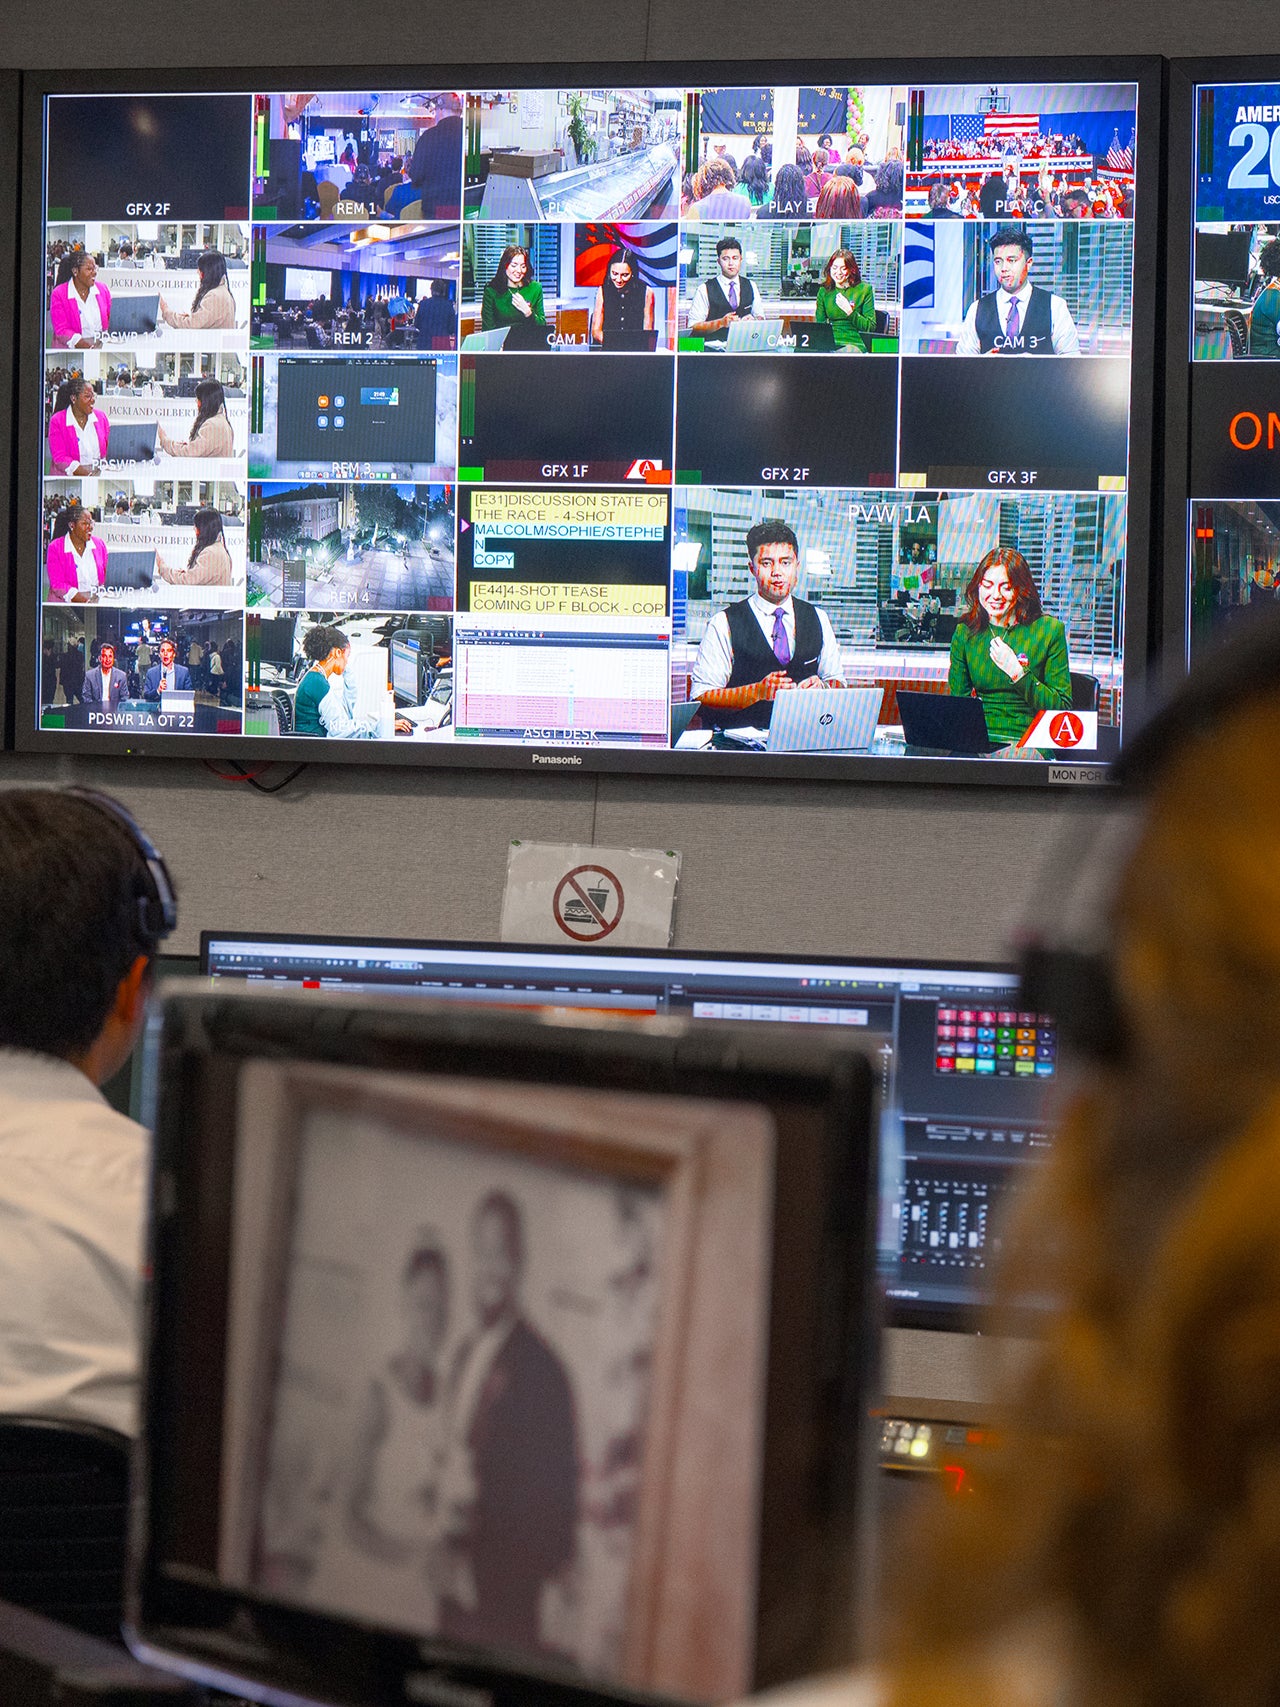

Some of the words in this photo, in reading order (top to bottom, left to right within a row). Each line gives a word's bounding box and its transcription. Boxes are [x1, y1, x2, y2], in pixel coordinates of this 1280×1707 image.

[1263, 195, 1280, 204] USC
[126, 203, 151, 216] GFX
[155, 203, 171, 215] 2F
[336, 202, 364, 214] REM
[369, 203, 377, 214] 1
[768, 201, 801, 213] PLAY
[806, 201, 816, 213] B
[995, 200, 1030, 213] PLAY
[1032, 201, 1044, 213] C
[135, 278, 155, 289] AND
[157, 278, 199, 289] GILBERT
[334, 332, 362, 344] REM
[366, 333, 373, 344] 2
[546, 333, 575, 345] CAM
[580, 333, 588, 345] 1
[767, 335, 797, 347] CAM
[801, 336, 809, 346] 2
[993, 336, 1024, 348] CAM
[1028, 336, 1038, 348] 3
[133, 406, 153, 417] AND
[155, 406, 197, 418] GILBERT
[332, 462, 359, 474] REM
[541, 465, 569, 477] GFX
[573, 465, 589, 477] 1F
[761, 467, 789, 480] GFX
[793, 468, 810, 480] 2F
[988, 471, 1016, 483] GFX
[1020, 472, 1037, 484] 3F
[475, 494, 596, 507] [E31]DISCUSSION
[600, 495, 643, 507] STATE
[647, 496, 668, 508] OF
[475, 509, 503, 520] THE
[507, 509, 546, 521] RACE
[563, 510, 615, 522] 4-SHOT
[848, 505, 894, 523] PVW
[904, 506, 931, 523] 1A
[475, 524, 663, 538] MALCOLM/SOPHIE/STEPHE
[131, 533, 152, 544] AND
[153, 533, 195, 545] GILBERT
[475, 539, 485, 550] N
[474, 554, 513, 565] COPY
[331, 591, 358, 603] REM
[361, 592, 370, 603] 4
[473, 584, 559, 597] [E44]4-SHOT
[562, 586, 608, 598] TEASE
[473, 599, 531, 611] COMING
[535, 600, 555, 611] UP
[559, 601, 567, 611] F
[571, 601, 620, 612] BLOCK
[632, 603, 666, 614] COP
[88, 712, 134, 725] PDSWR
[139, 714, 154, 726] 1A
[157, 715, 176, 727] OT
[178, 715, 194, 727] 22
[562, 728, 599, 740] DESK
[532, 754, 582, 765] Panasonic
[1052, 770, 1076, 780] MON
